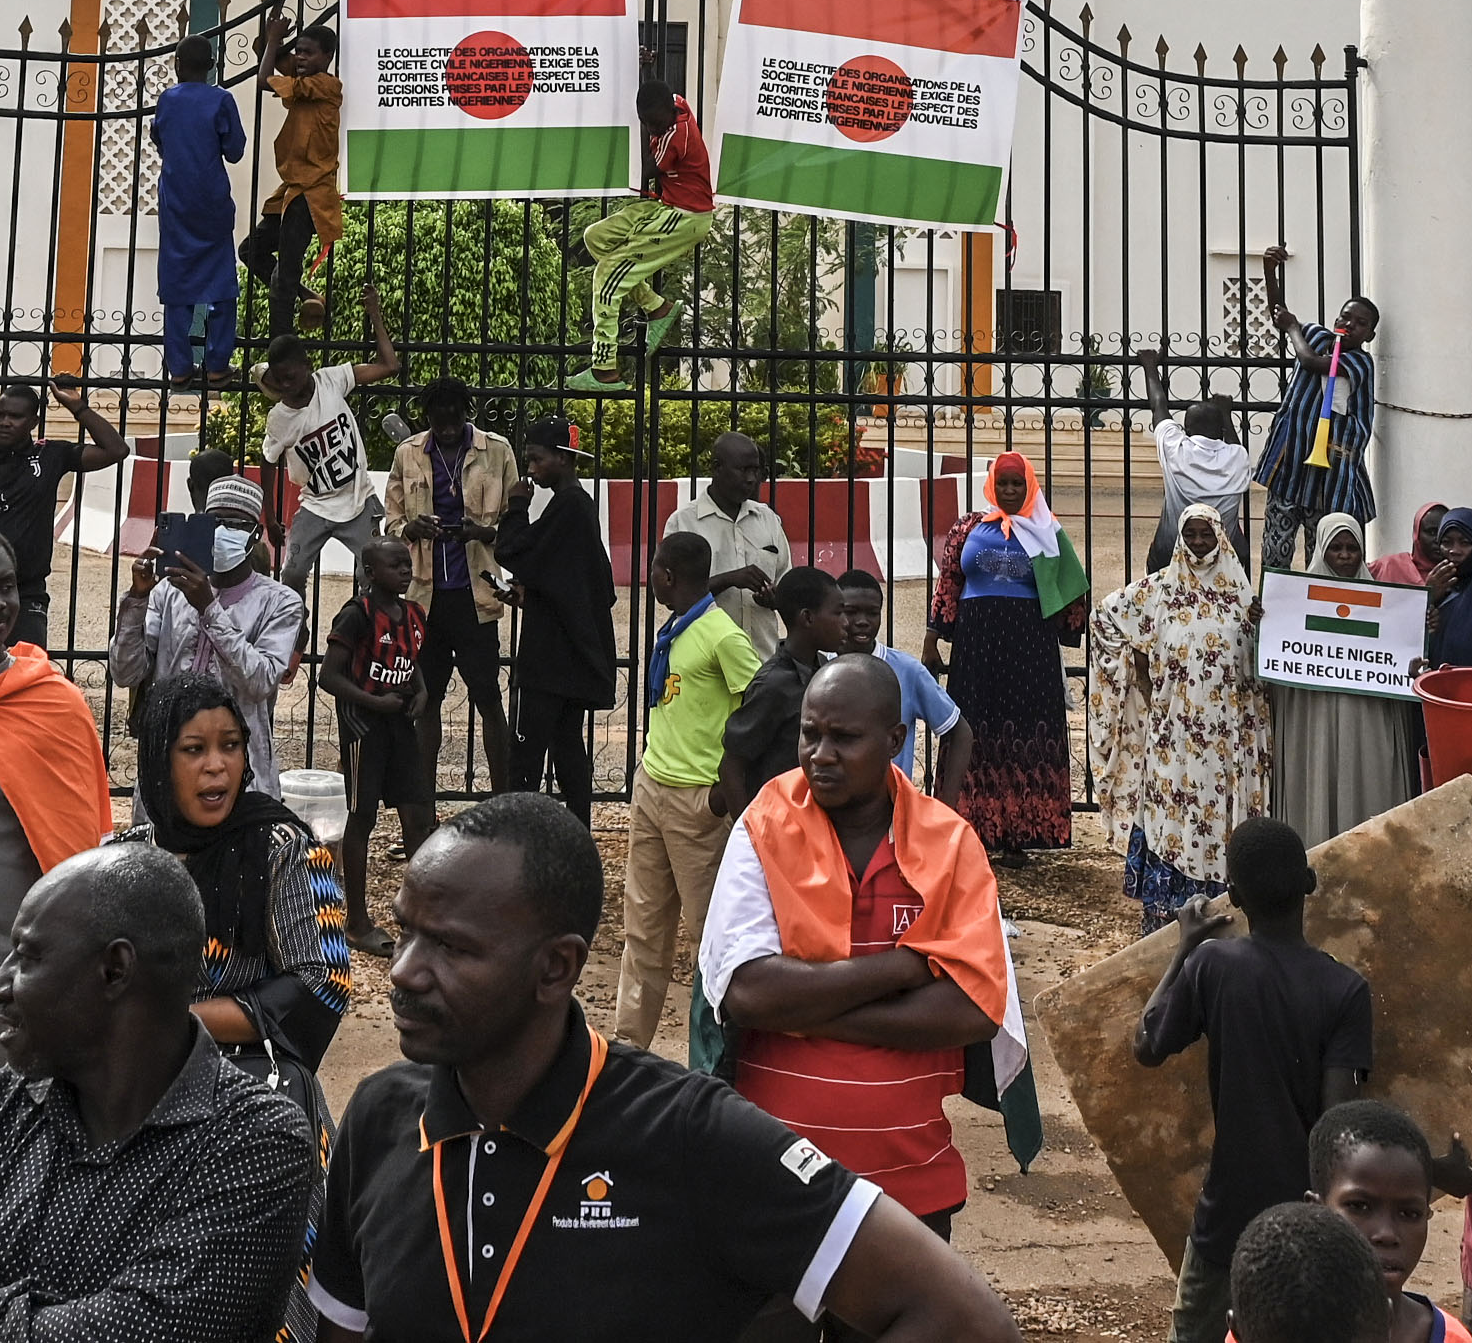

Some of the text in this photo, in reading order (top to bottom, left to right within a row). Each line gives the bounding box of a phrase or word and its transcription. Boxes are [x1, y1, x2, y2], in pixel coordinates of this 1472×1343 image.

[378, 47, 598, 58] LE COLLECTIF DES ORGANISATIONS DE LA
[378, 58, 599, 70] SOCIETE CIVILE NIGERIENNE EXIGE DES
[378, 70, 599, 83] AUTORITES FRANCAISES LE RESPECT DES
[378, 83, 600, 95] DECISIONS PRISES PAR LES NOUVELLES
[762, 69, 980, 105] SOCIETE CIVILE NIGERIENNE EXIGE DES
[763, 58, 981, 93] LE COLLECTIF DES ORGANISATIONS DE LA
[378, 96, 525, 107] AUTORITES NIGERIENNES
[758, 94, 977, 129] DECISIONS PRISES PAR LES NOUVELLES
[760, 82, 979, 117] AUTORITES FRANCAISES LE RESPECT DES
[757, 106, 900, 131] AUTORITES NIGERIENNES
[295, 413, 350, 473] INTER
[307, 431, 360, 495] VIEW
[1282, 640, 1398, 668] POUR LE NIGER,
[1264, 658, 1412, 687] JE NE RECULE POINT
